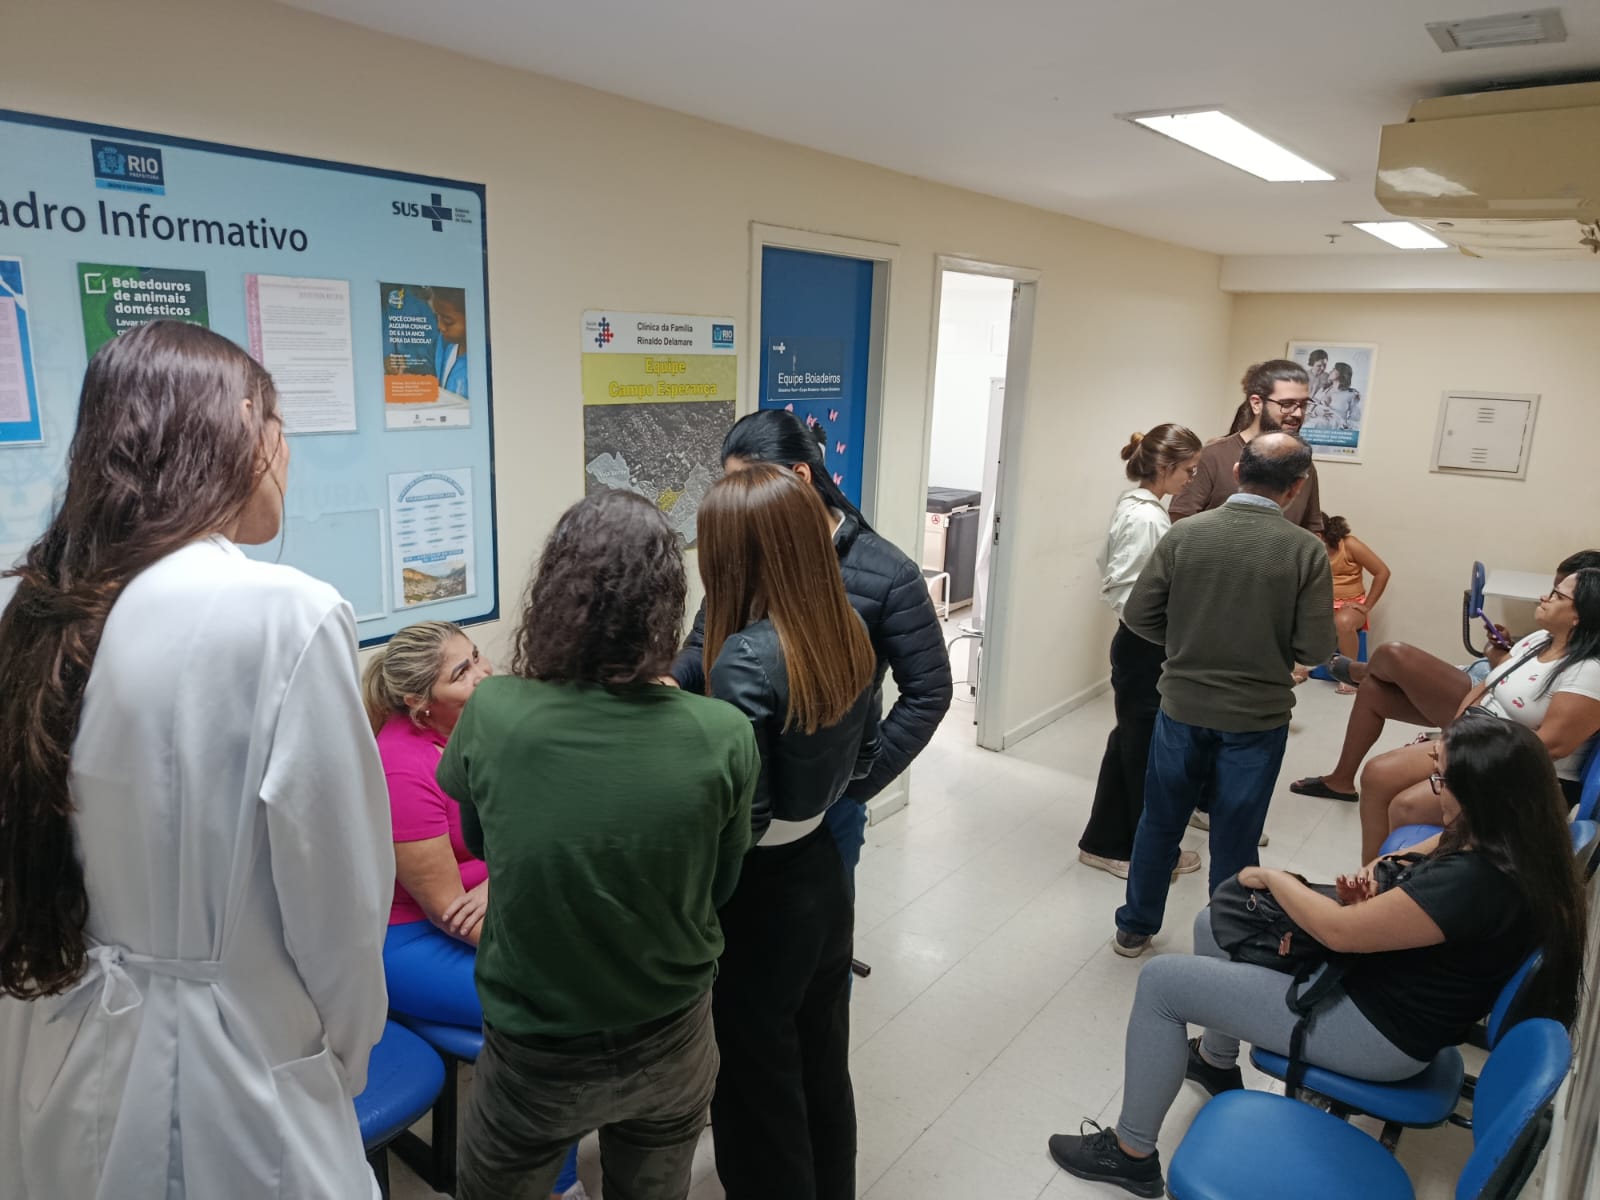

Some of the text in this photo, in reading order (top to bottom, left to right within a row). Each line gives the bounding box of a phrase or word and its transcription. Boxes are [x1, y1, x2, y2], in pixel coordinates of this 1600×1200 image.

[128, 155, 159, 175] RIO
[392, 200, 419, 218] SUS
[98, 200, 308, 252] Informativo
[112, 277, 191, 292] Bebedouros
[113, 290, 186, 304] de animais
[115, 303, 191, 316] domésticos
[661, 323, 670, 332] da
[722, 329, 733, 338] RIO
[637, 336, 693, 346] Rinaldo Delamare
[644, 357, 687, 376] Equipe
[778, 372, 841, 387] Equipe Boiadeiros
[608, 380, 718, 399] Campo Esperança
